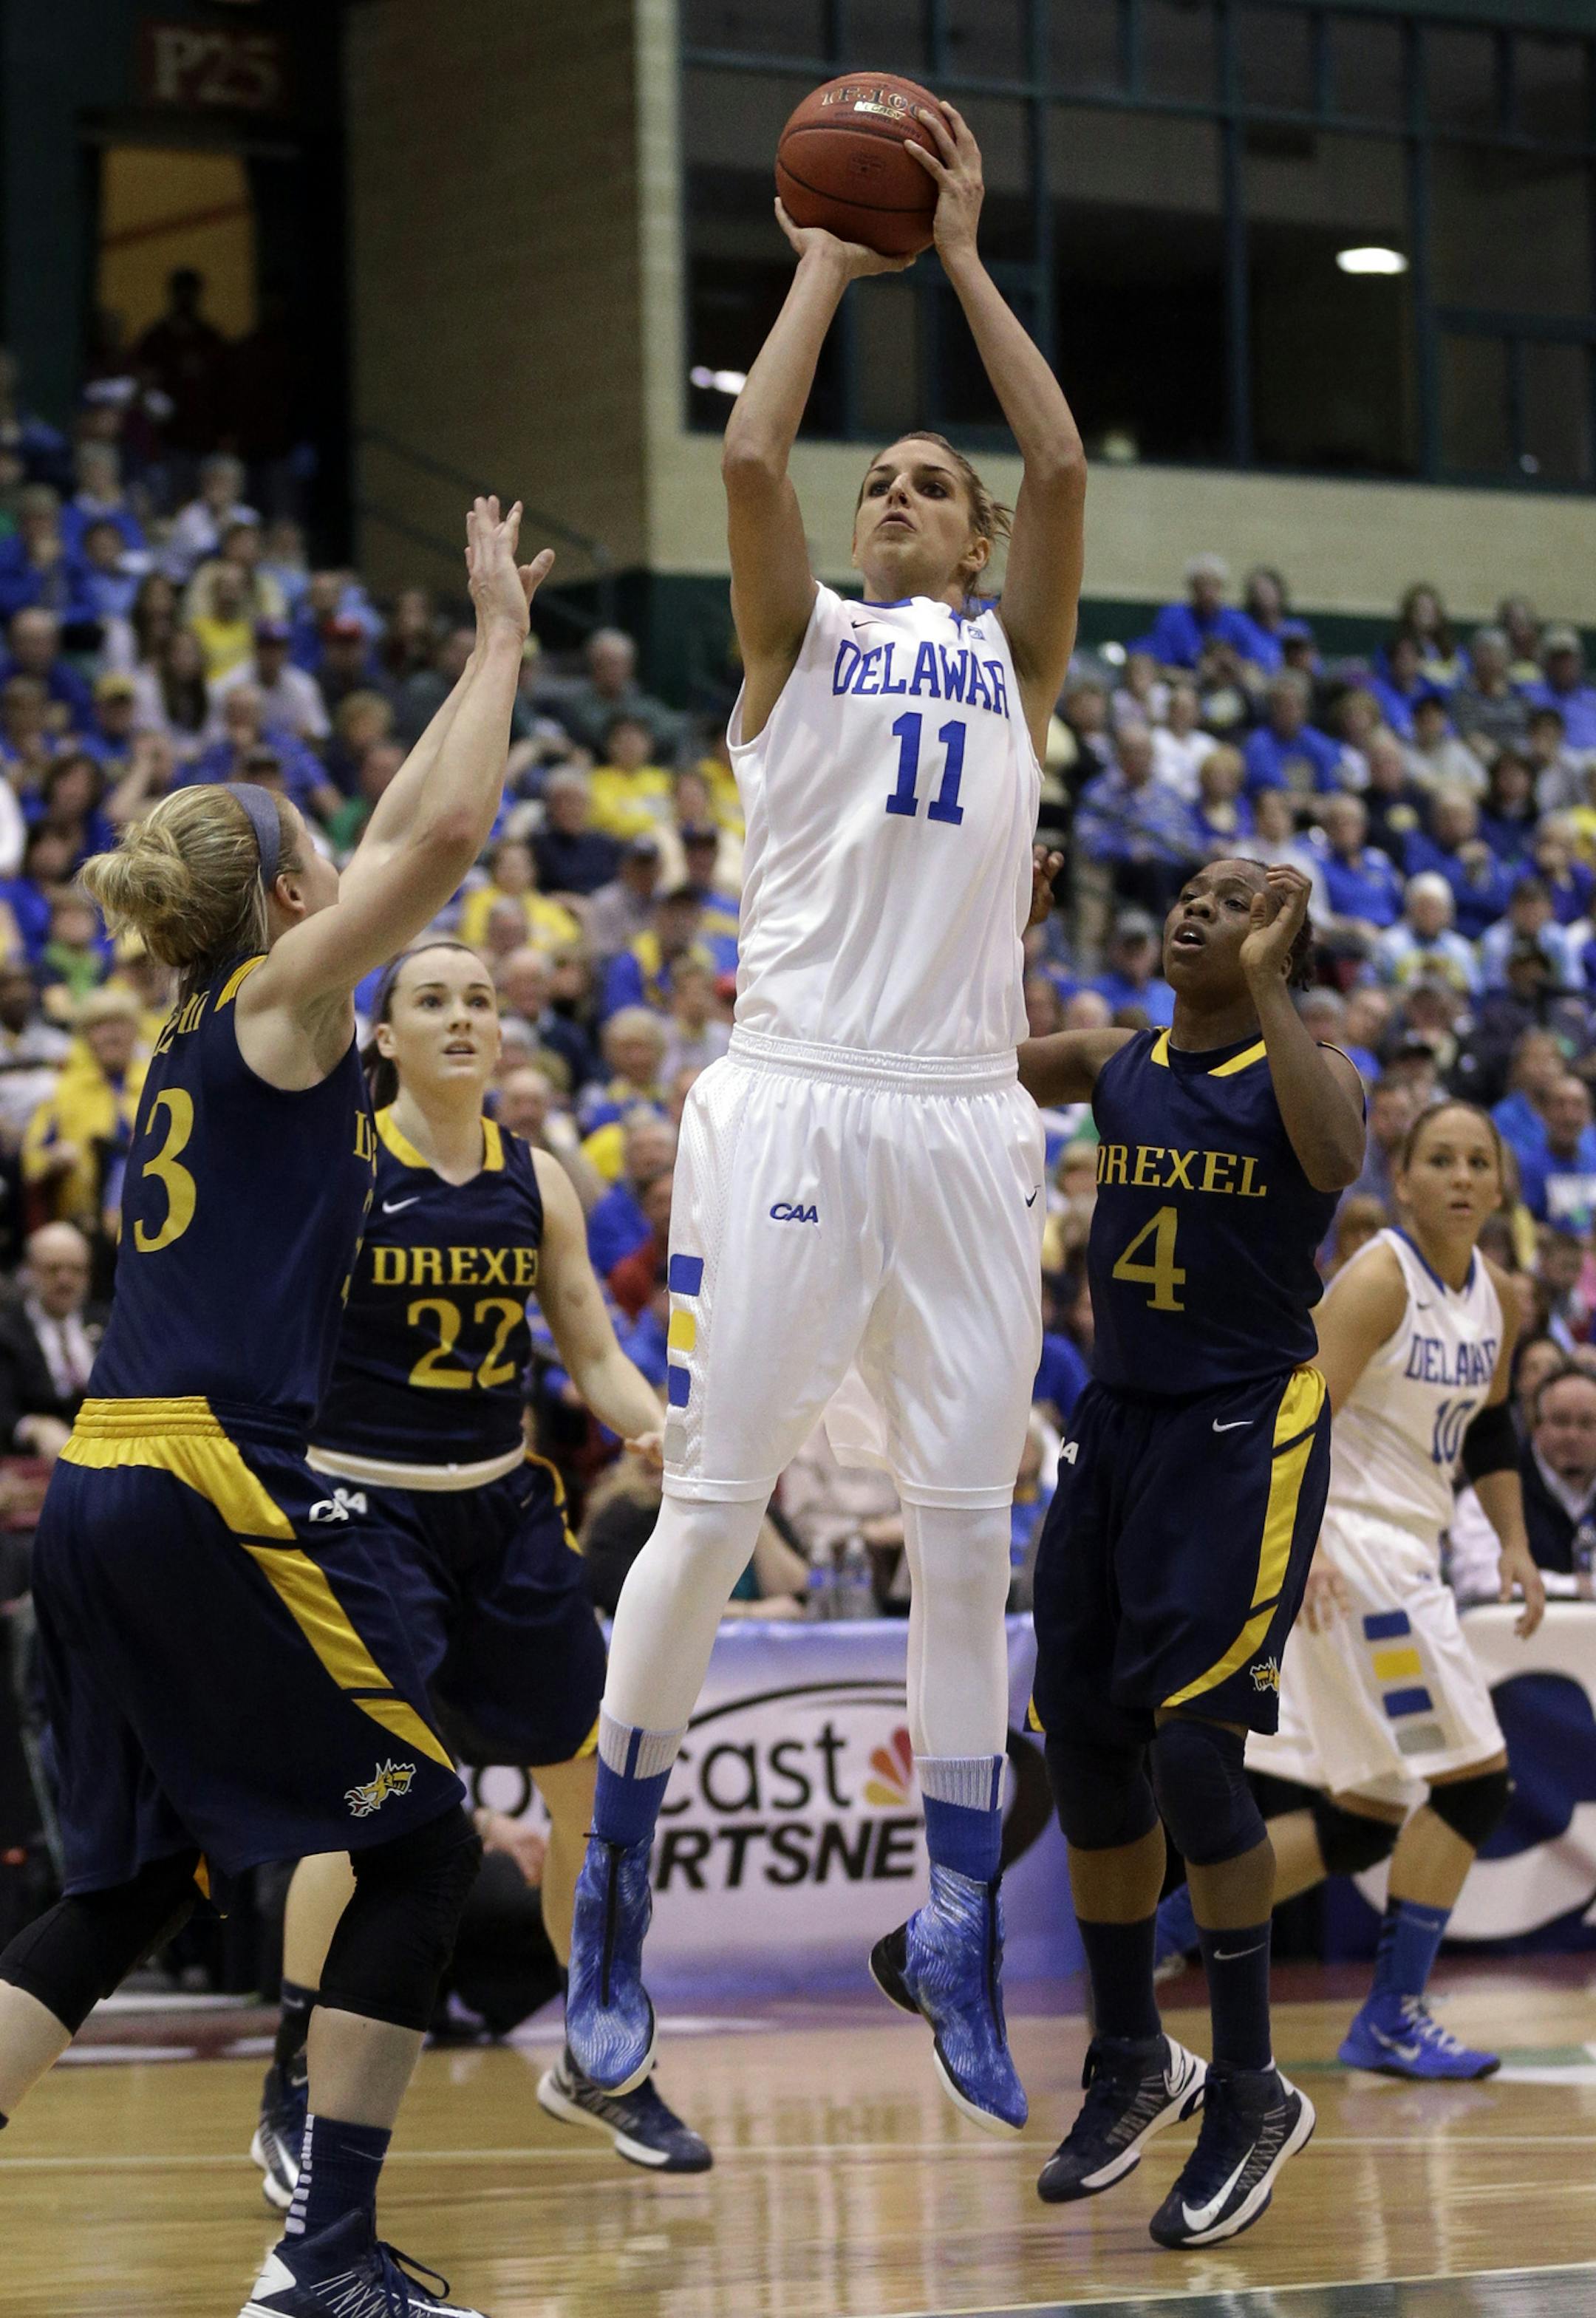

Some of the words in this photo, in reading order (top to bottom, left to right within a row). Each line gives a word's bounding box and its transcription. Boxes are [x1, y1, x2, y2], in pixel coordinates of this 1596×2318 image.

[153, 27, 282, 103] P25
[886, 712, 967, 825] 11
[117, 1087, 197, 1252] 3
[769, 1202, 818, 1223] CAA
[372, 1246, 538, 1286] DREXE
[1112, 1206, 1186, 1312] 4
[407, 1298, 524, 1390] 22
[1432, 1399, 1476, 1465] 10
[655, 1819, 921, 1890] RTSNE
